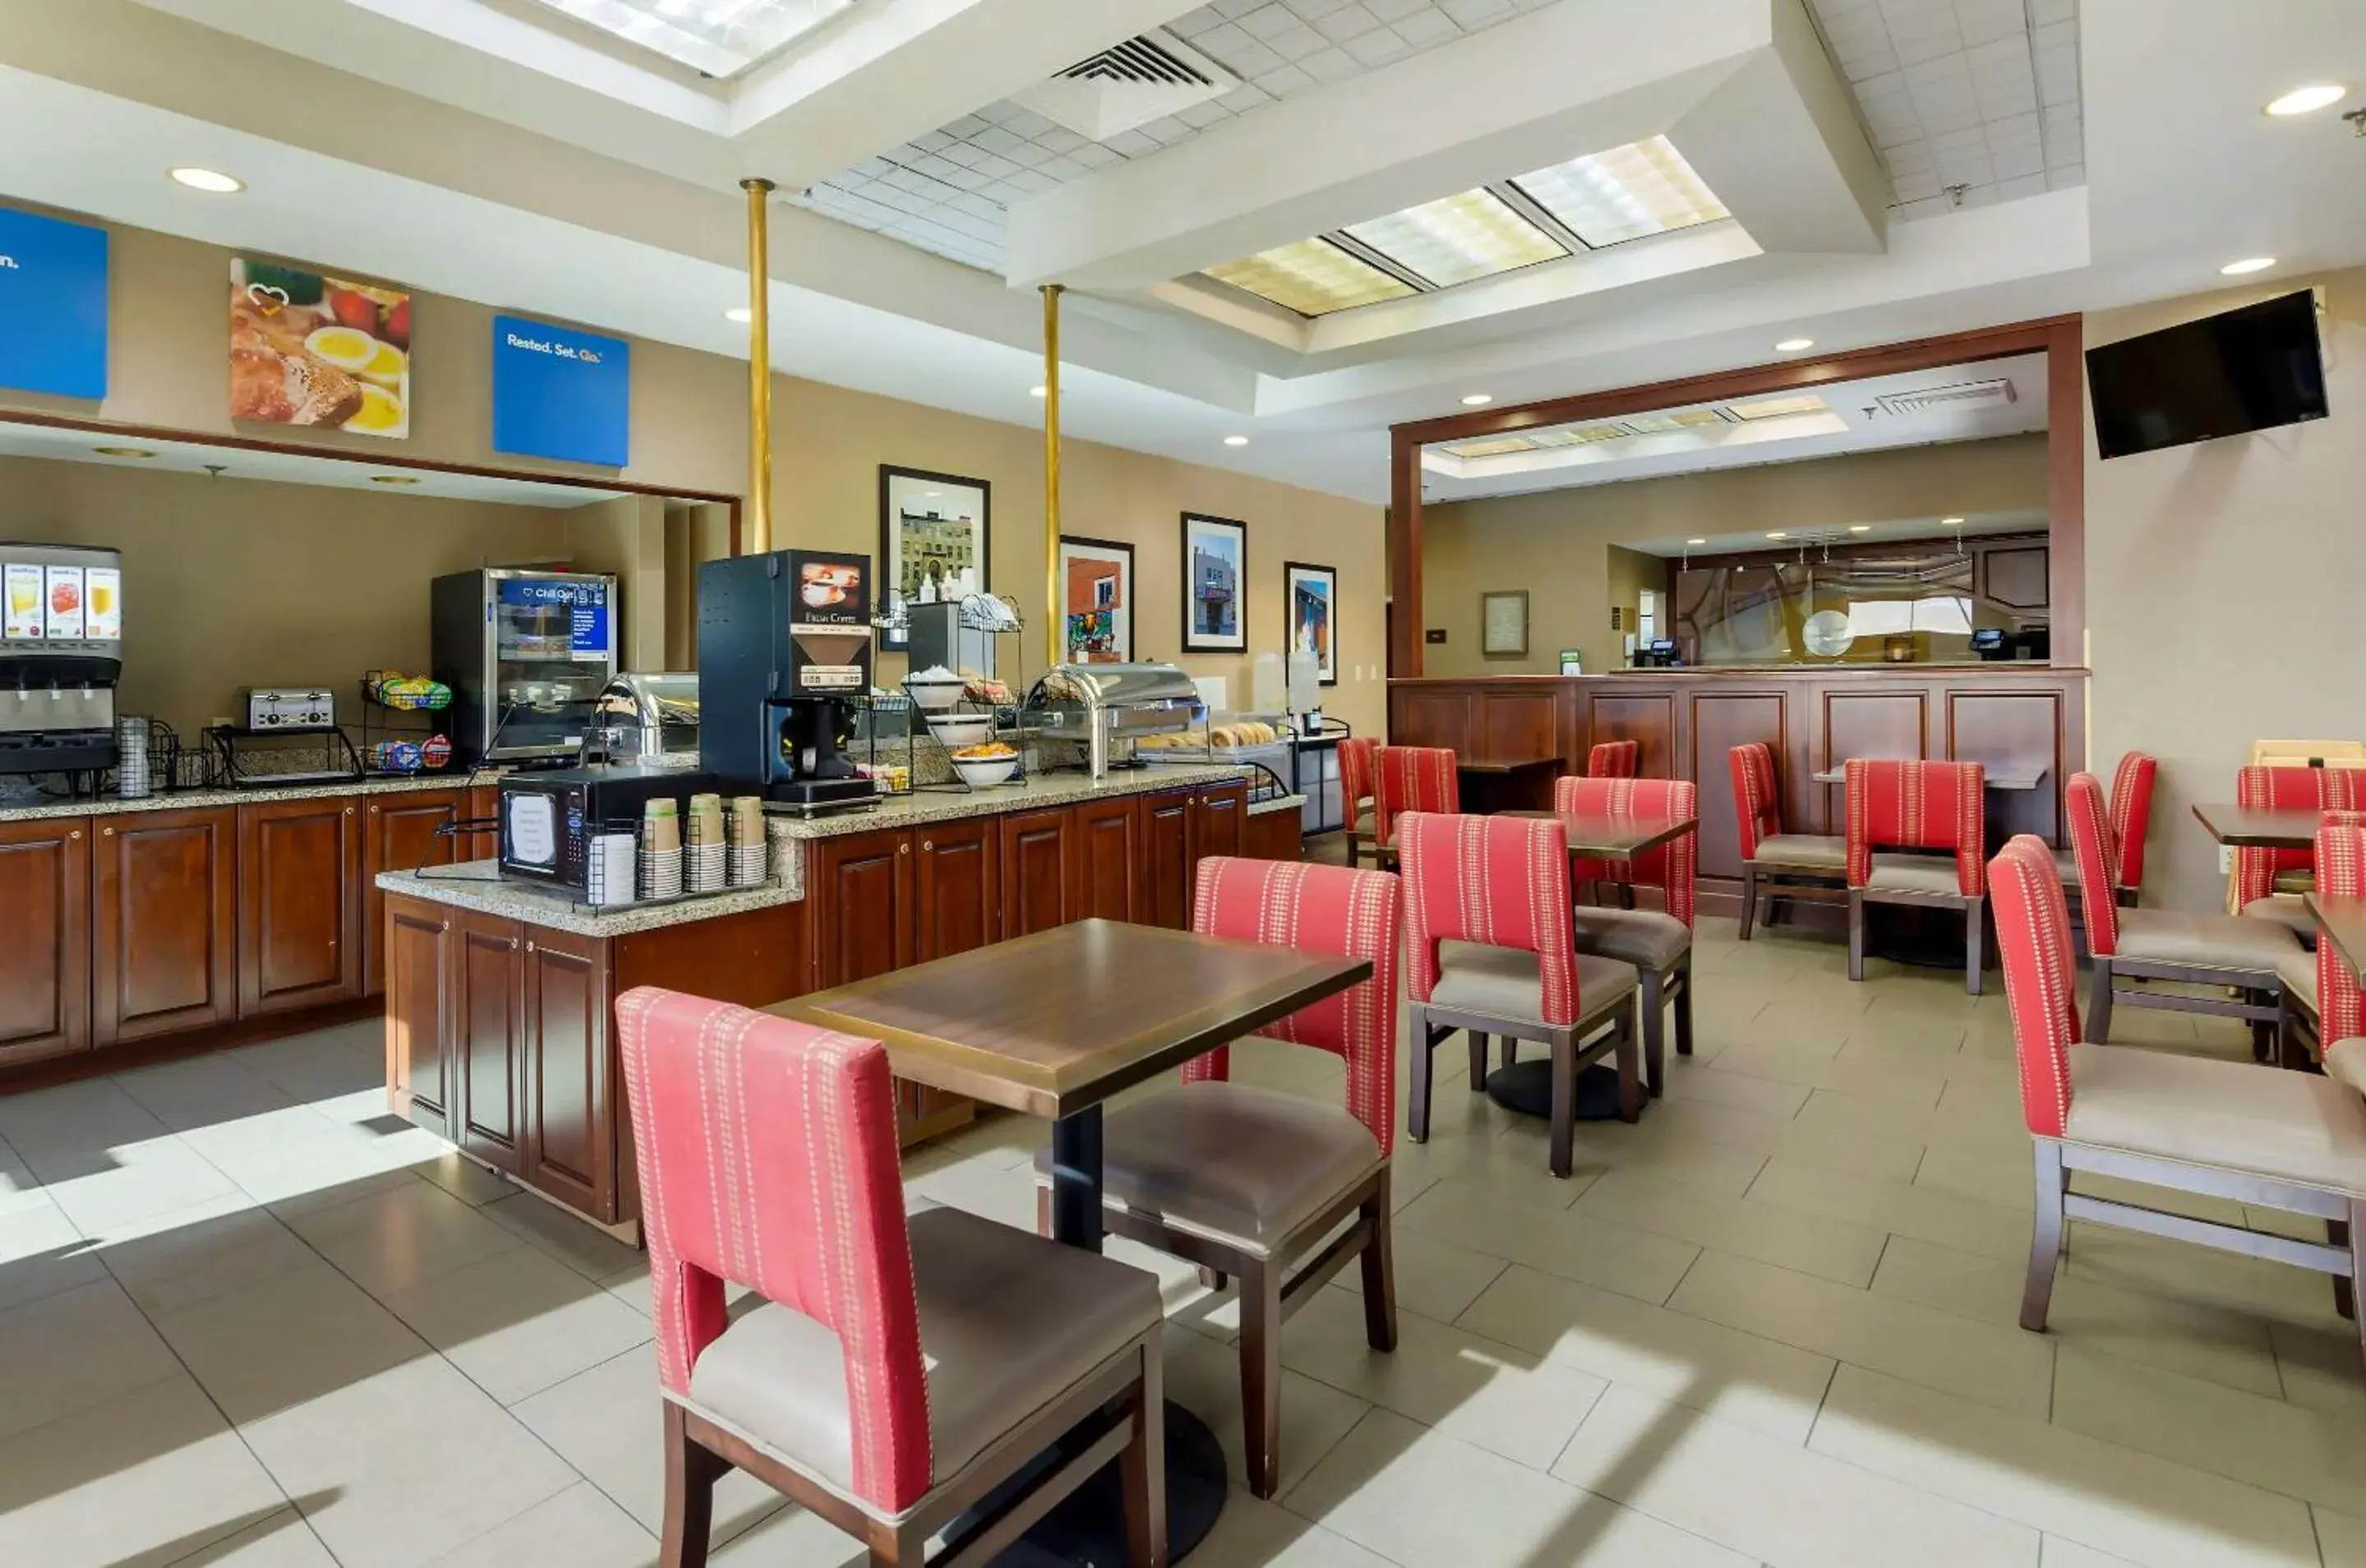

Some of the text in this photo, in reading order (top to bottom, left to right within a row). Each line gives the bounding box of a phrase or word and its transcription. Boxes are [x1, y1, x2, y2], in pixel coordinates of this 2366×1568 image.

[507, 333, 601, 363] Rested. Set. Go.
